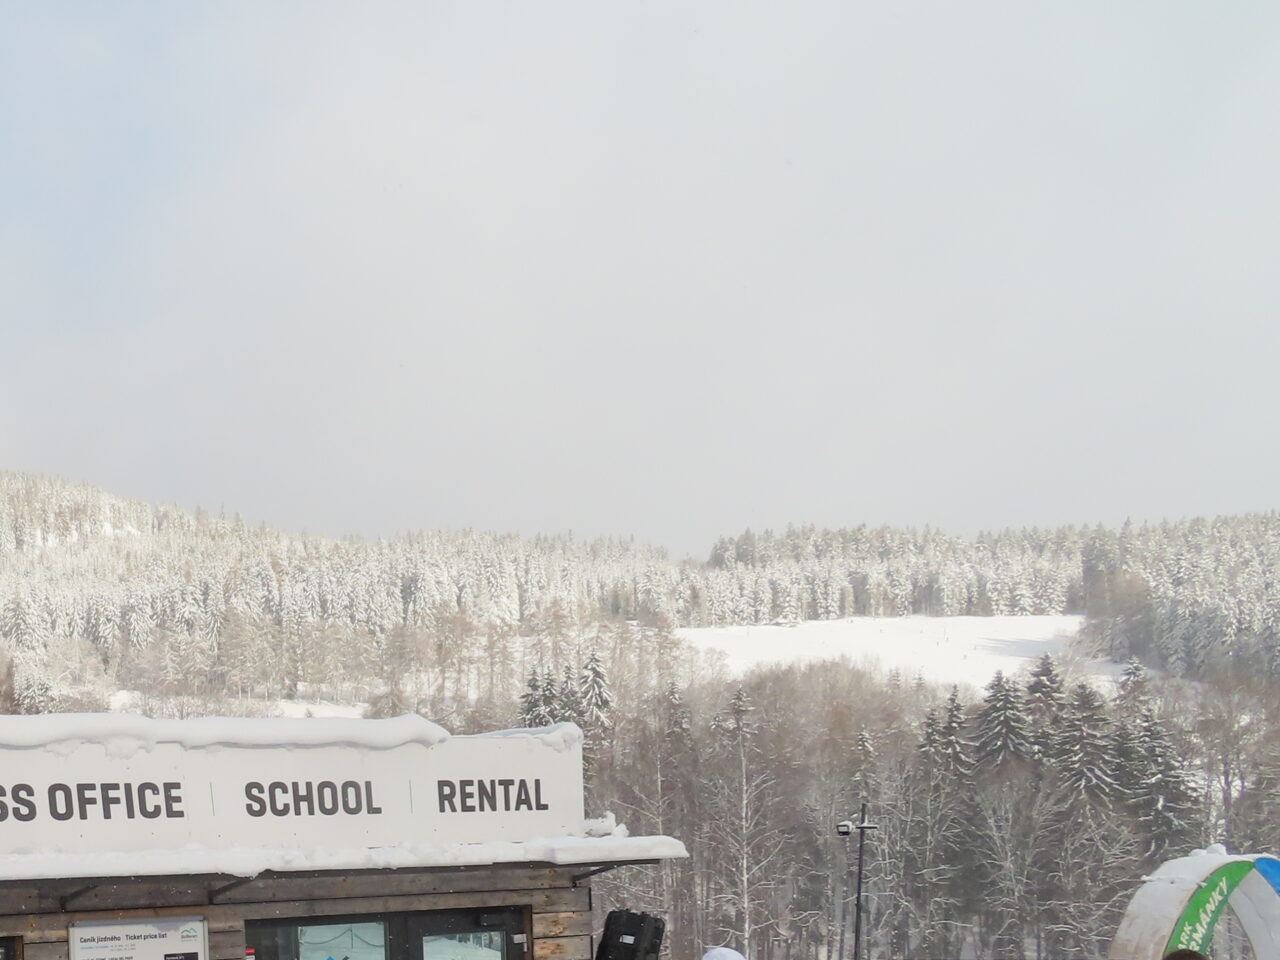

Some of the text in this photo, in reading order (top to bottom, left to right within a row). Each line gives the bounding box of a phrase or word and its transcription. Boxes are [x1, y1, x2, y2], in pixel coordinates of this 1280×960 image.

[48, 781, 185, 821] OFFICE
[245, 780, 382, 817] SCHOOL
[437, 778, 549, 813] RENTAL
